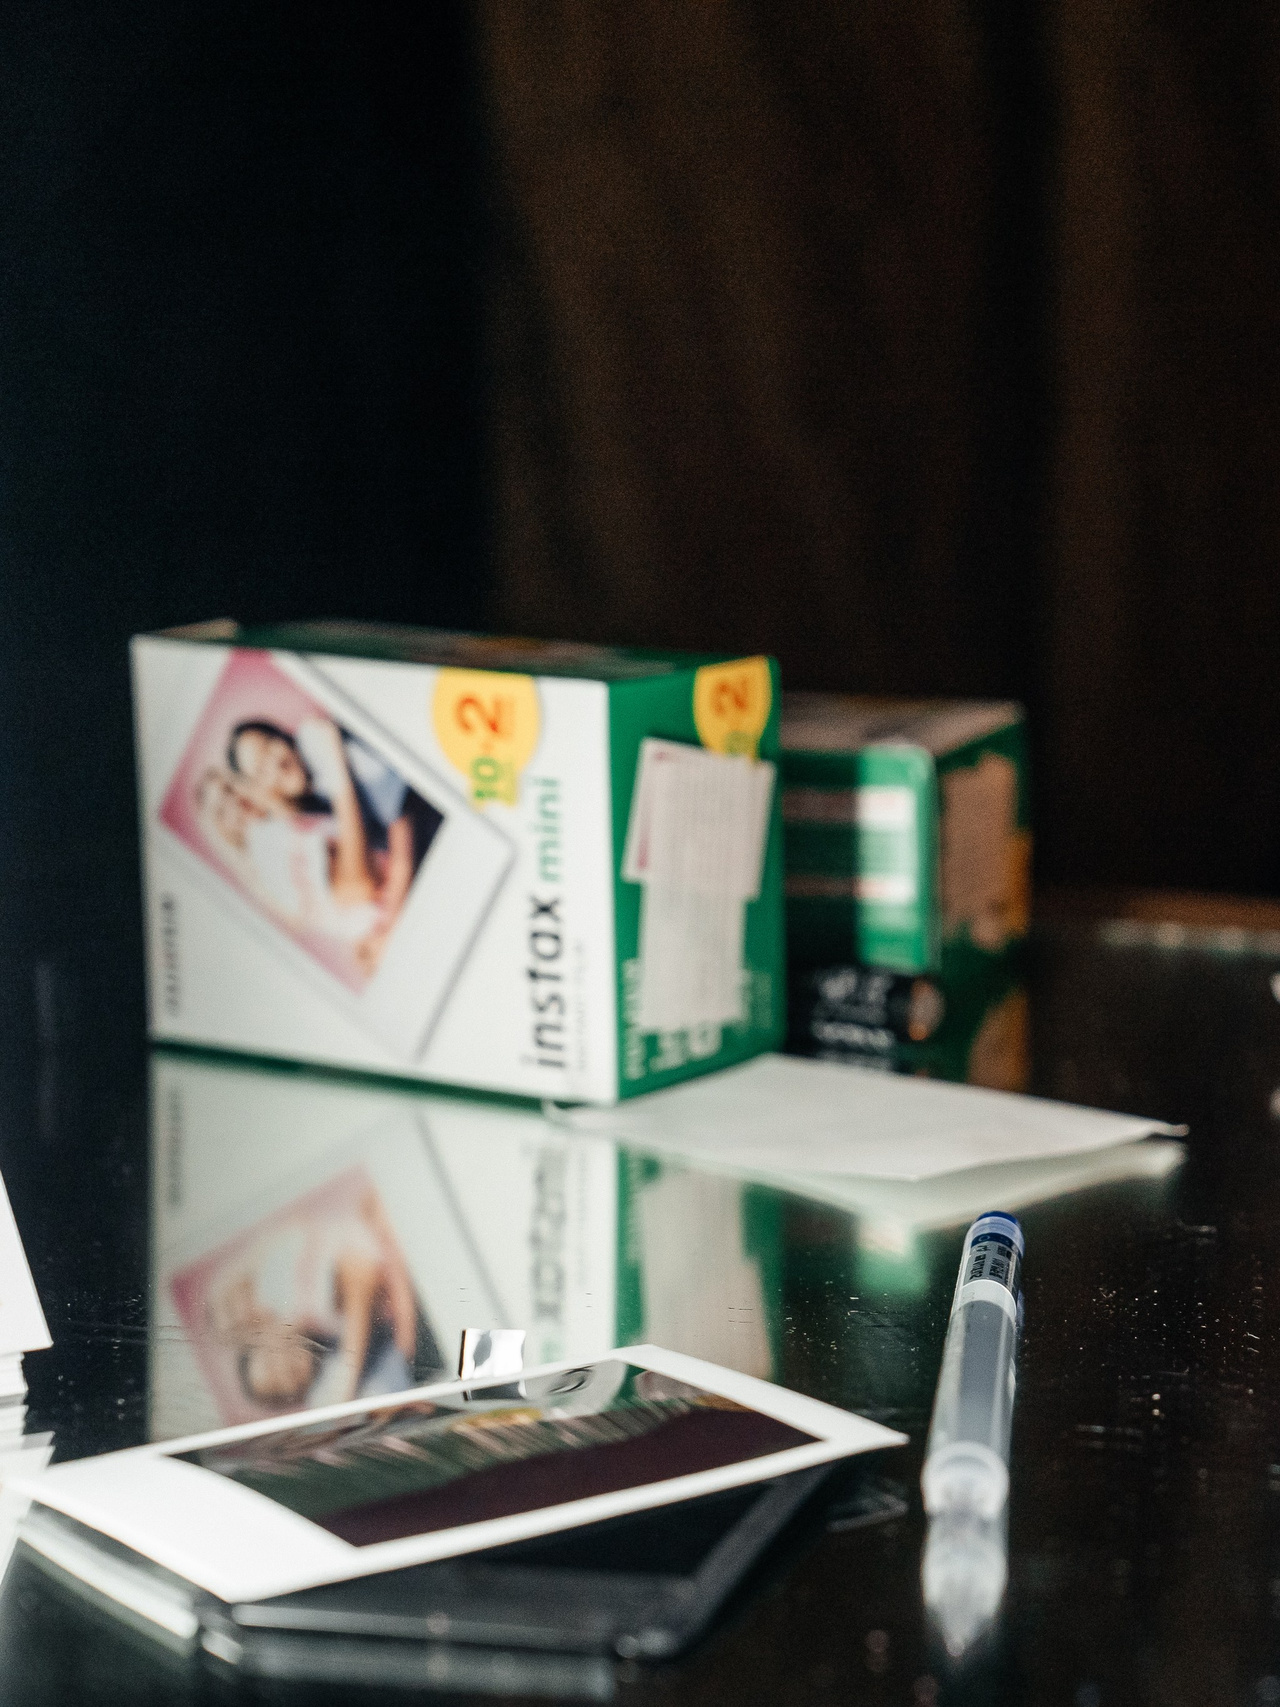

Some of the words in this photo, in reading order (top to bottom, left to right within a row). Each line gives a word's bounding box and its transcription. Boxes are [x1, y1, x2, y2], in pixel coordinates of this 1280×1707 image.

[454, 692, 501, 736] 2
[710, 677, 749, 716] 2
[473, 756, 501, 800] 10
[528, 775, 562, 884] mini
[521, 894, 566, 1071] instax
